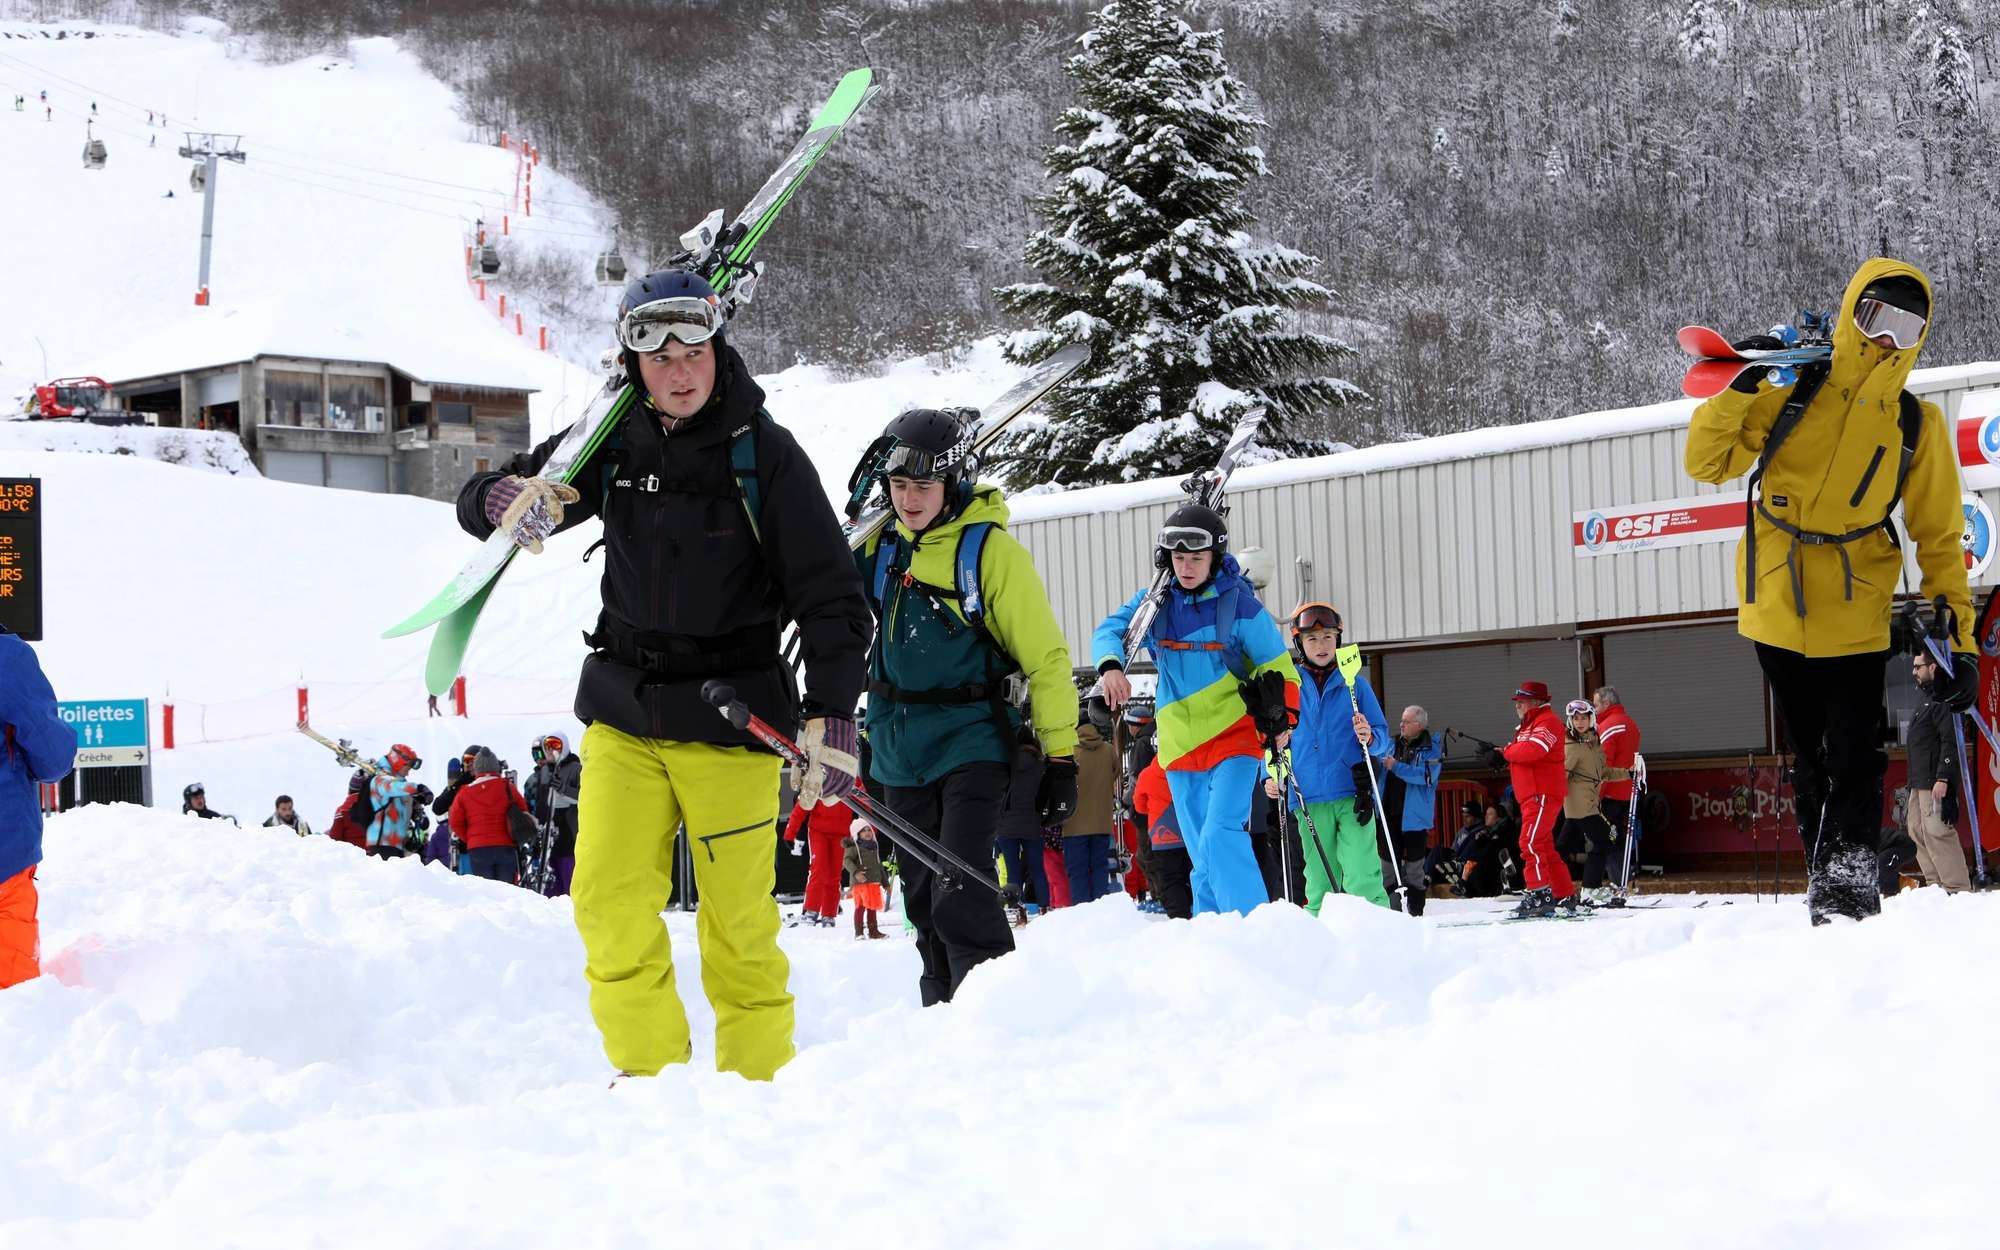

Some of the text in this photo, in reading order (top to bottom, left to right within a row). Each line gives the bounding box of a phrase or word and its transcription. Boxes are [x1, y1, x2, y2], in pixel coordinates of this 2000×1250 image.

[57, 705, 135, 723] Toilettes
[78, 752, 113, 763] Crèche
[1688, 791, 1735, 820] Piou
